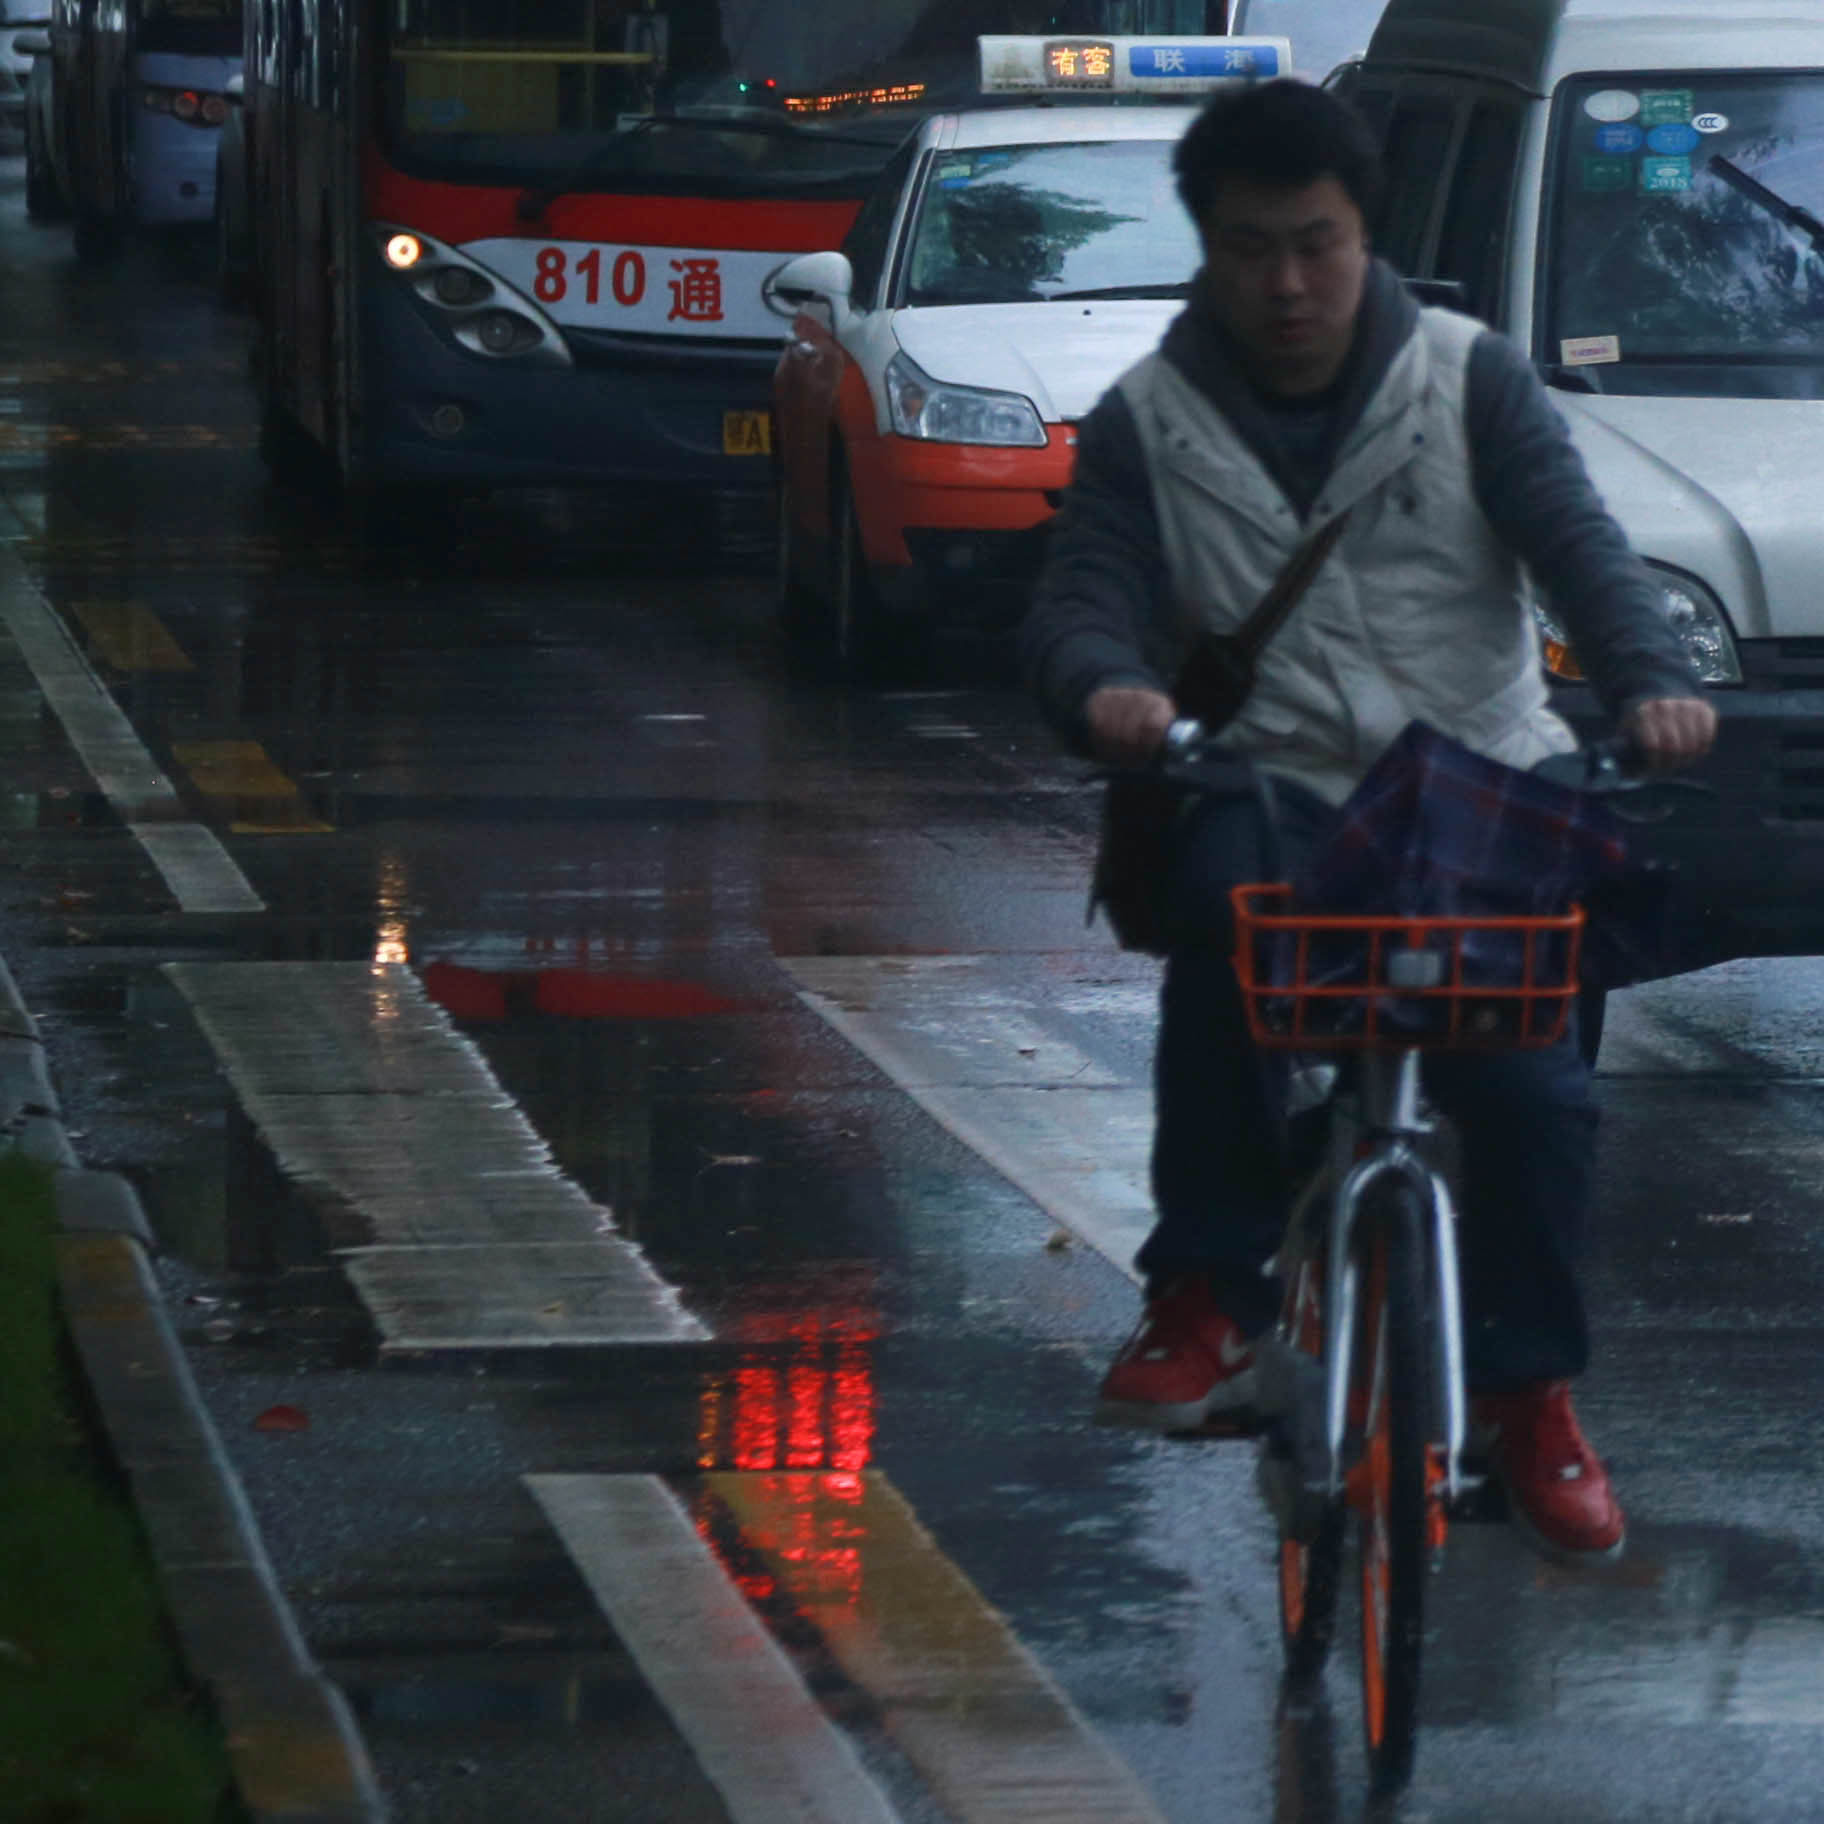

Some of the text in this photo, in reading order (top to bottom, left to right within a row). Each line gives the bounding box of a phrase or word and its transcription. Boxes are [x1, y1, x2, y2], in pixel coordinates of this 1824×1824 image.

[1051, 46, 1112, 76] 有客
[533, 246, 725, 322] 810 通
